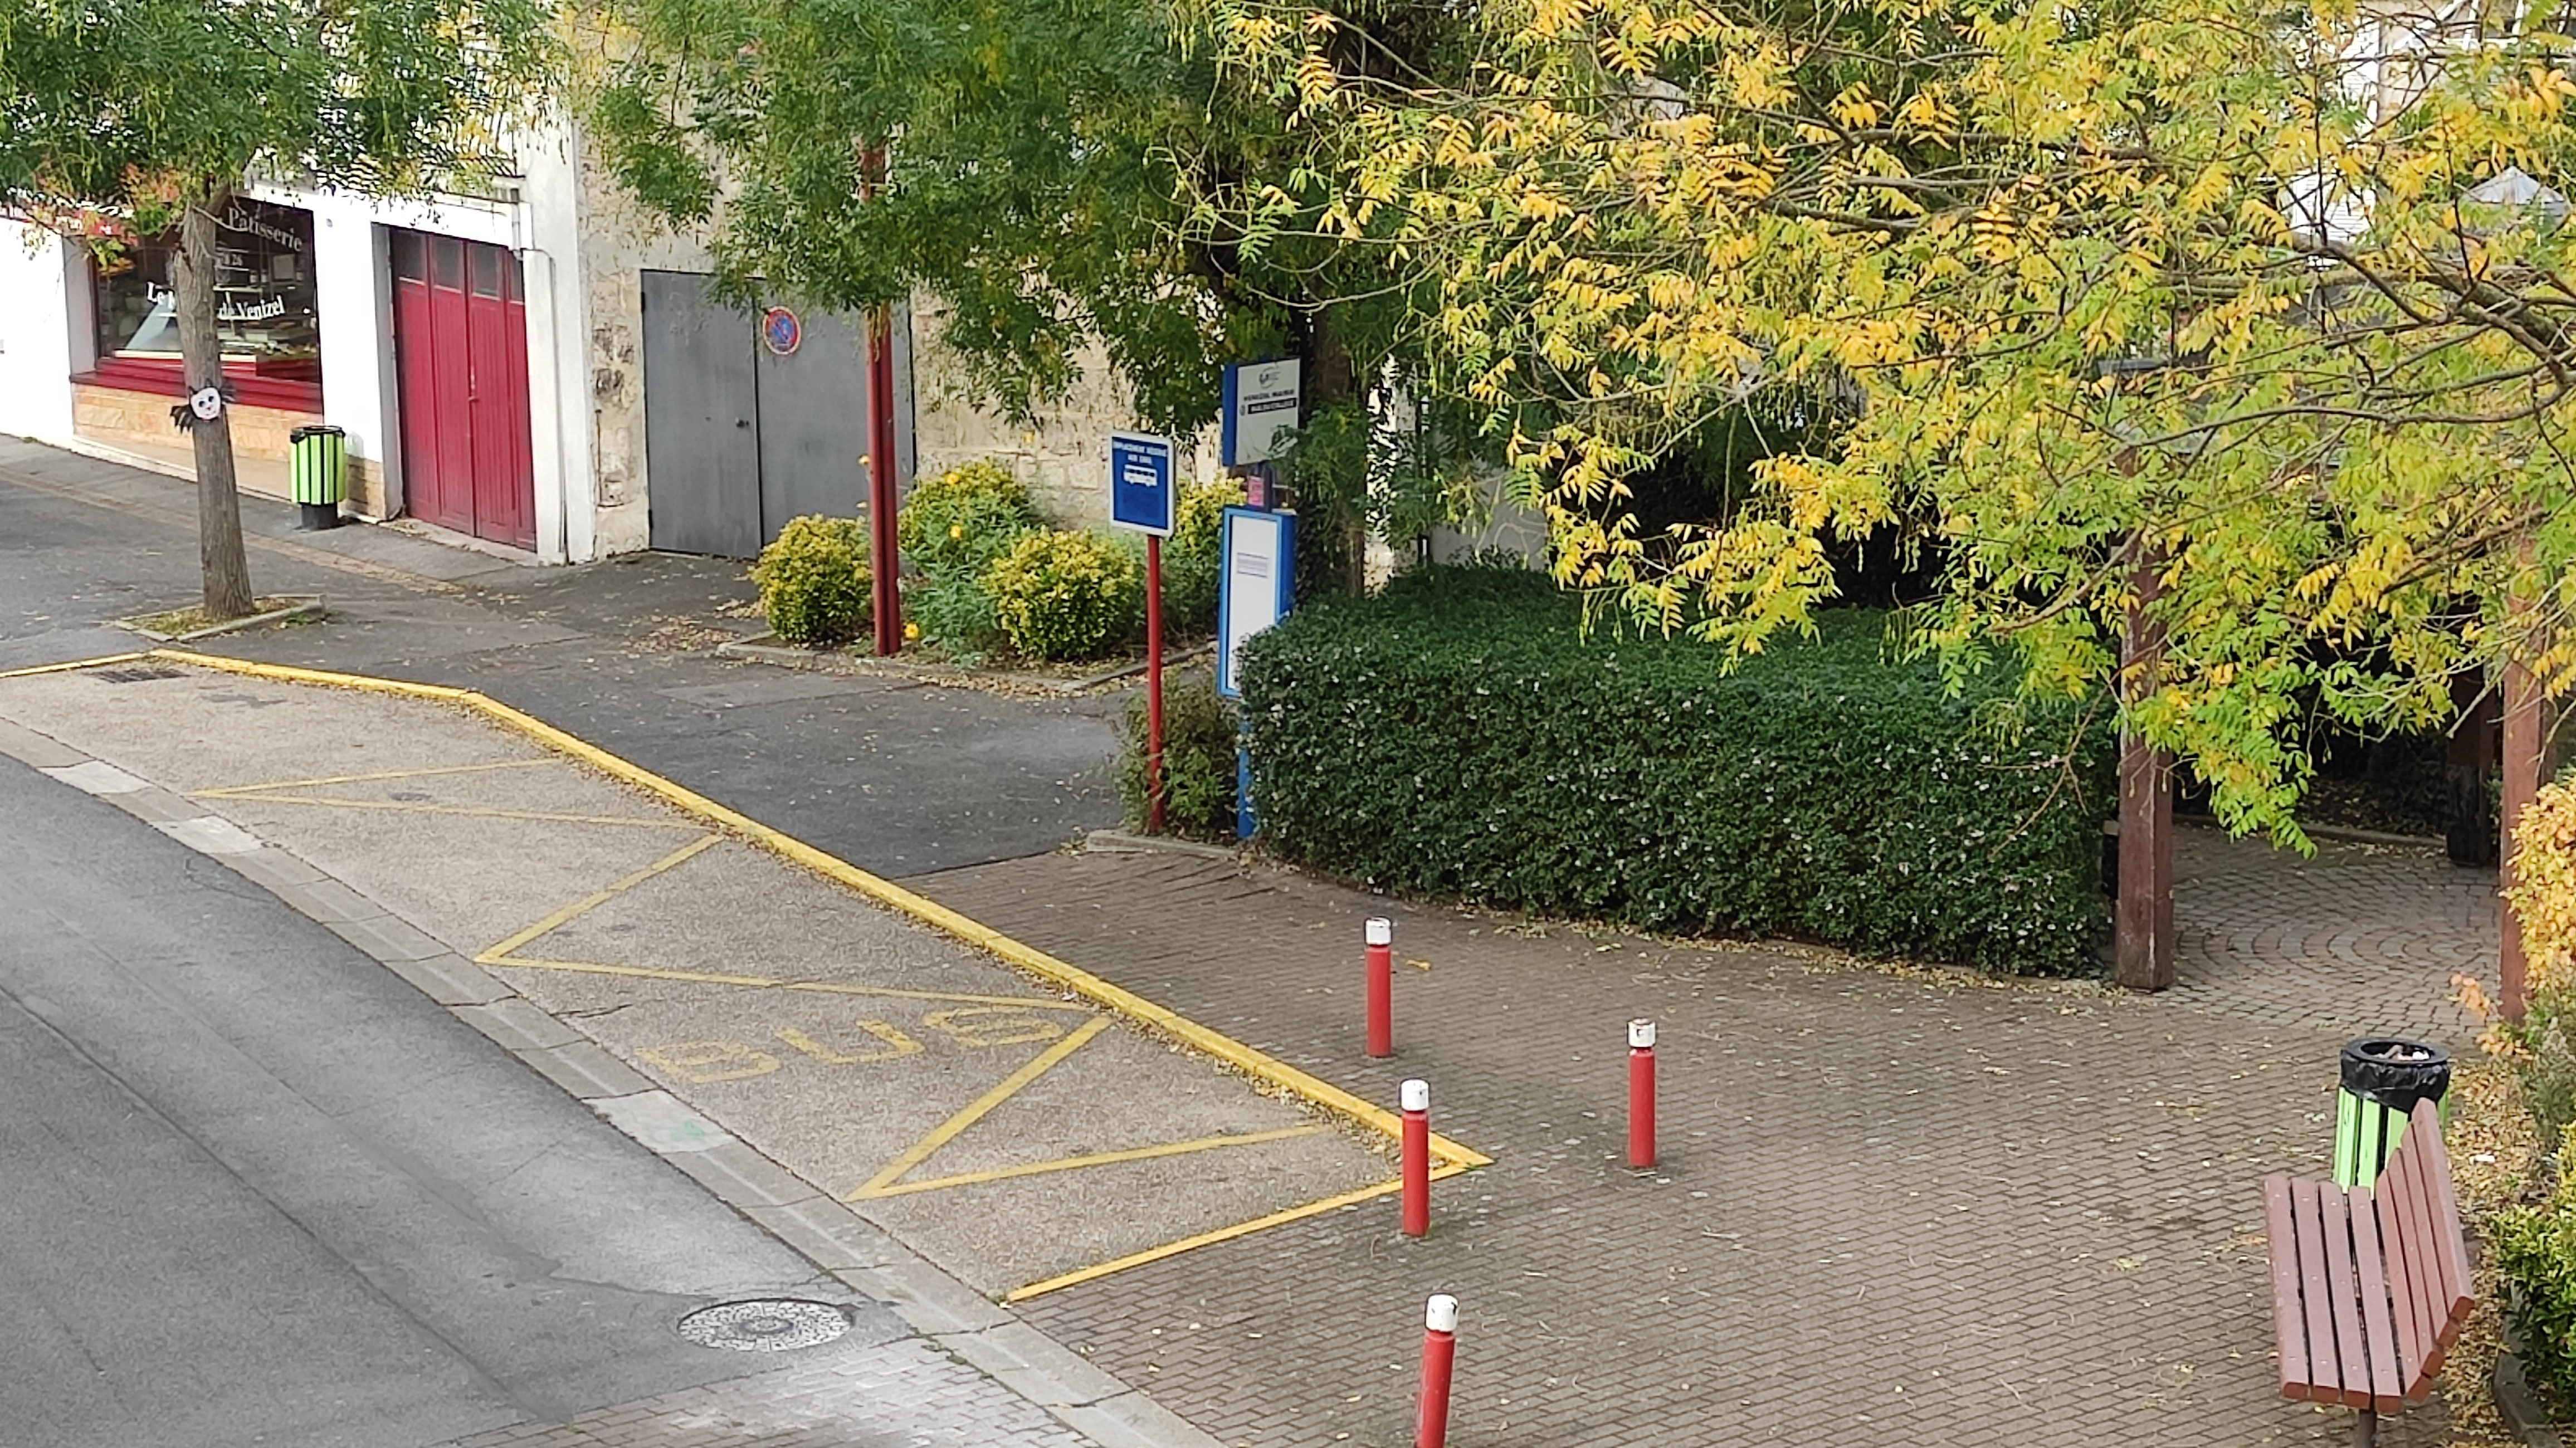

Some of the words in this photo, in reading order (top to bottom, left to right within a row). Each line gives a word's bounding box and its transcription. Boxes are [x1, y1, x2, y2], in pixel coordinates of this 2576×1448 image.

[147, 281, 164, 305] Le
[236, 295, 286, 319] Venizel
[637, 1004, 1064, 1083] BUS
